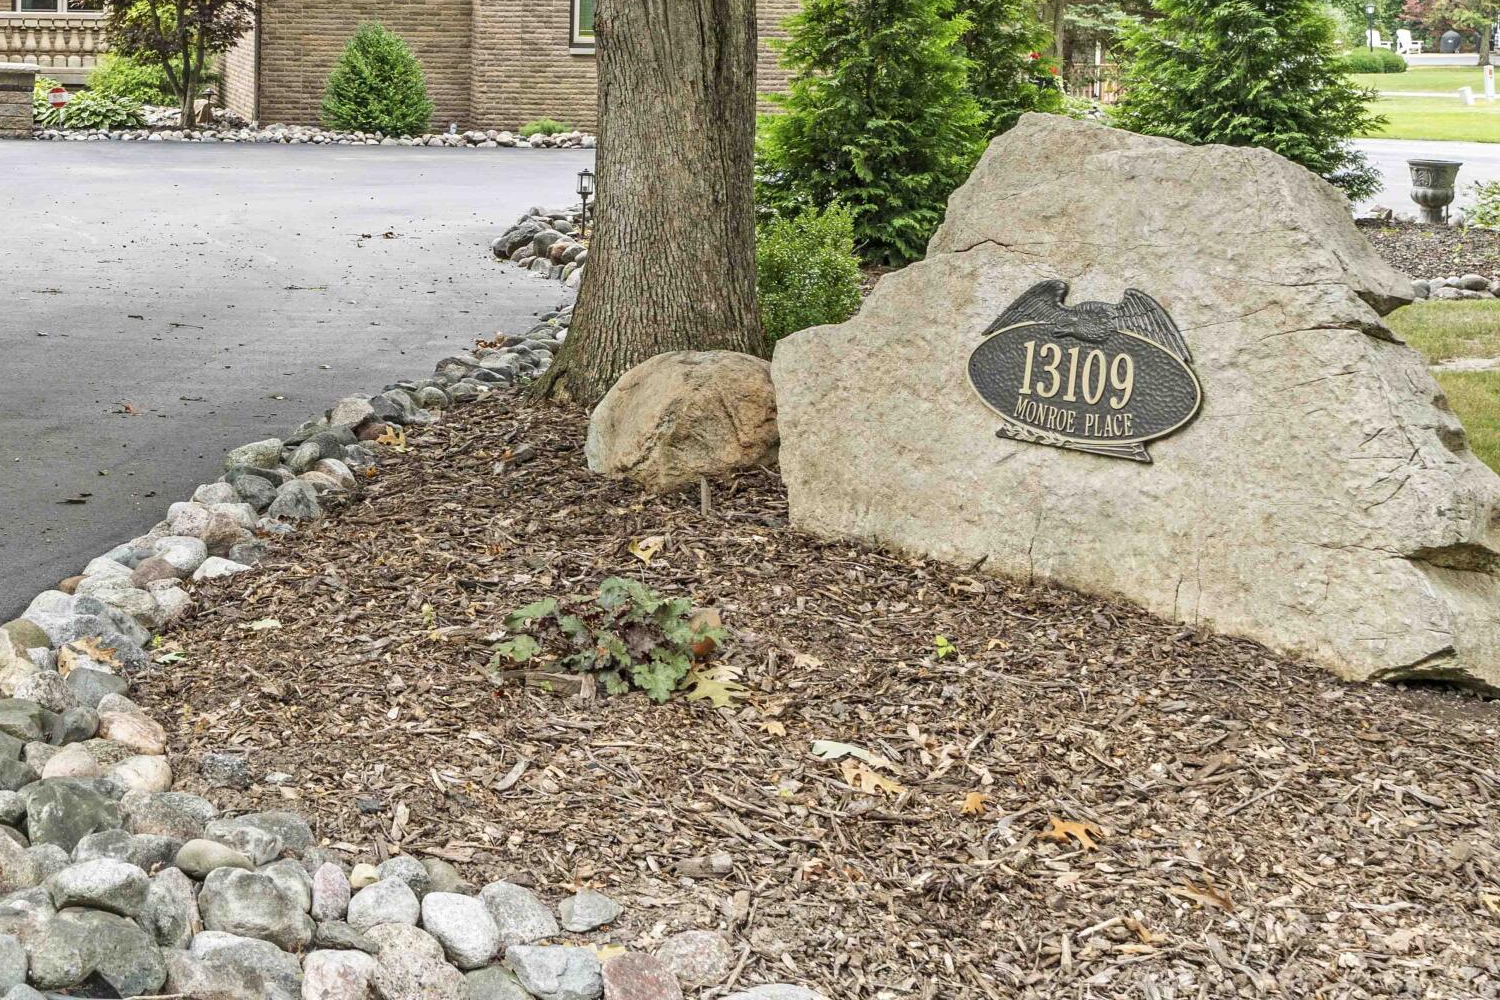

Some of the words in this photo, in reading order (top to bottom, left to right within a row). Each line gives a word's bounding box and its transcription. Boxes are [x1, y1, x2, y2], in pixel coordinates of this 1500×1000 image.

[1018, 340, 1134, 410] 13109
[1013, 396, 1077, 433] MONROE
[1083, 413, 1133, 437] PLACE
